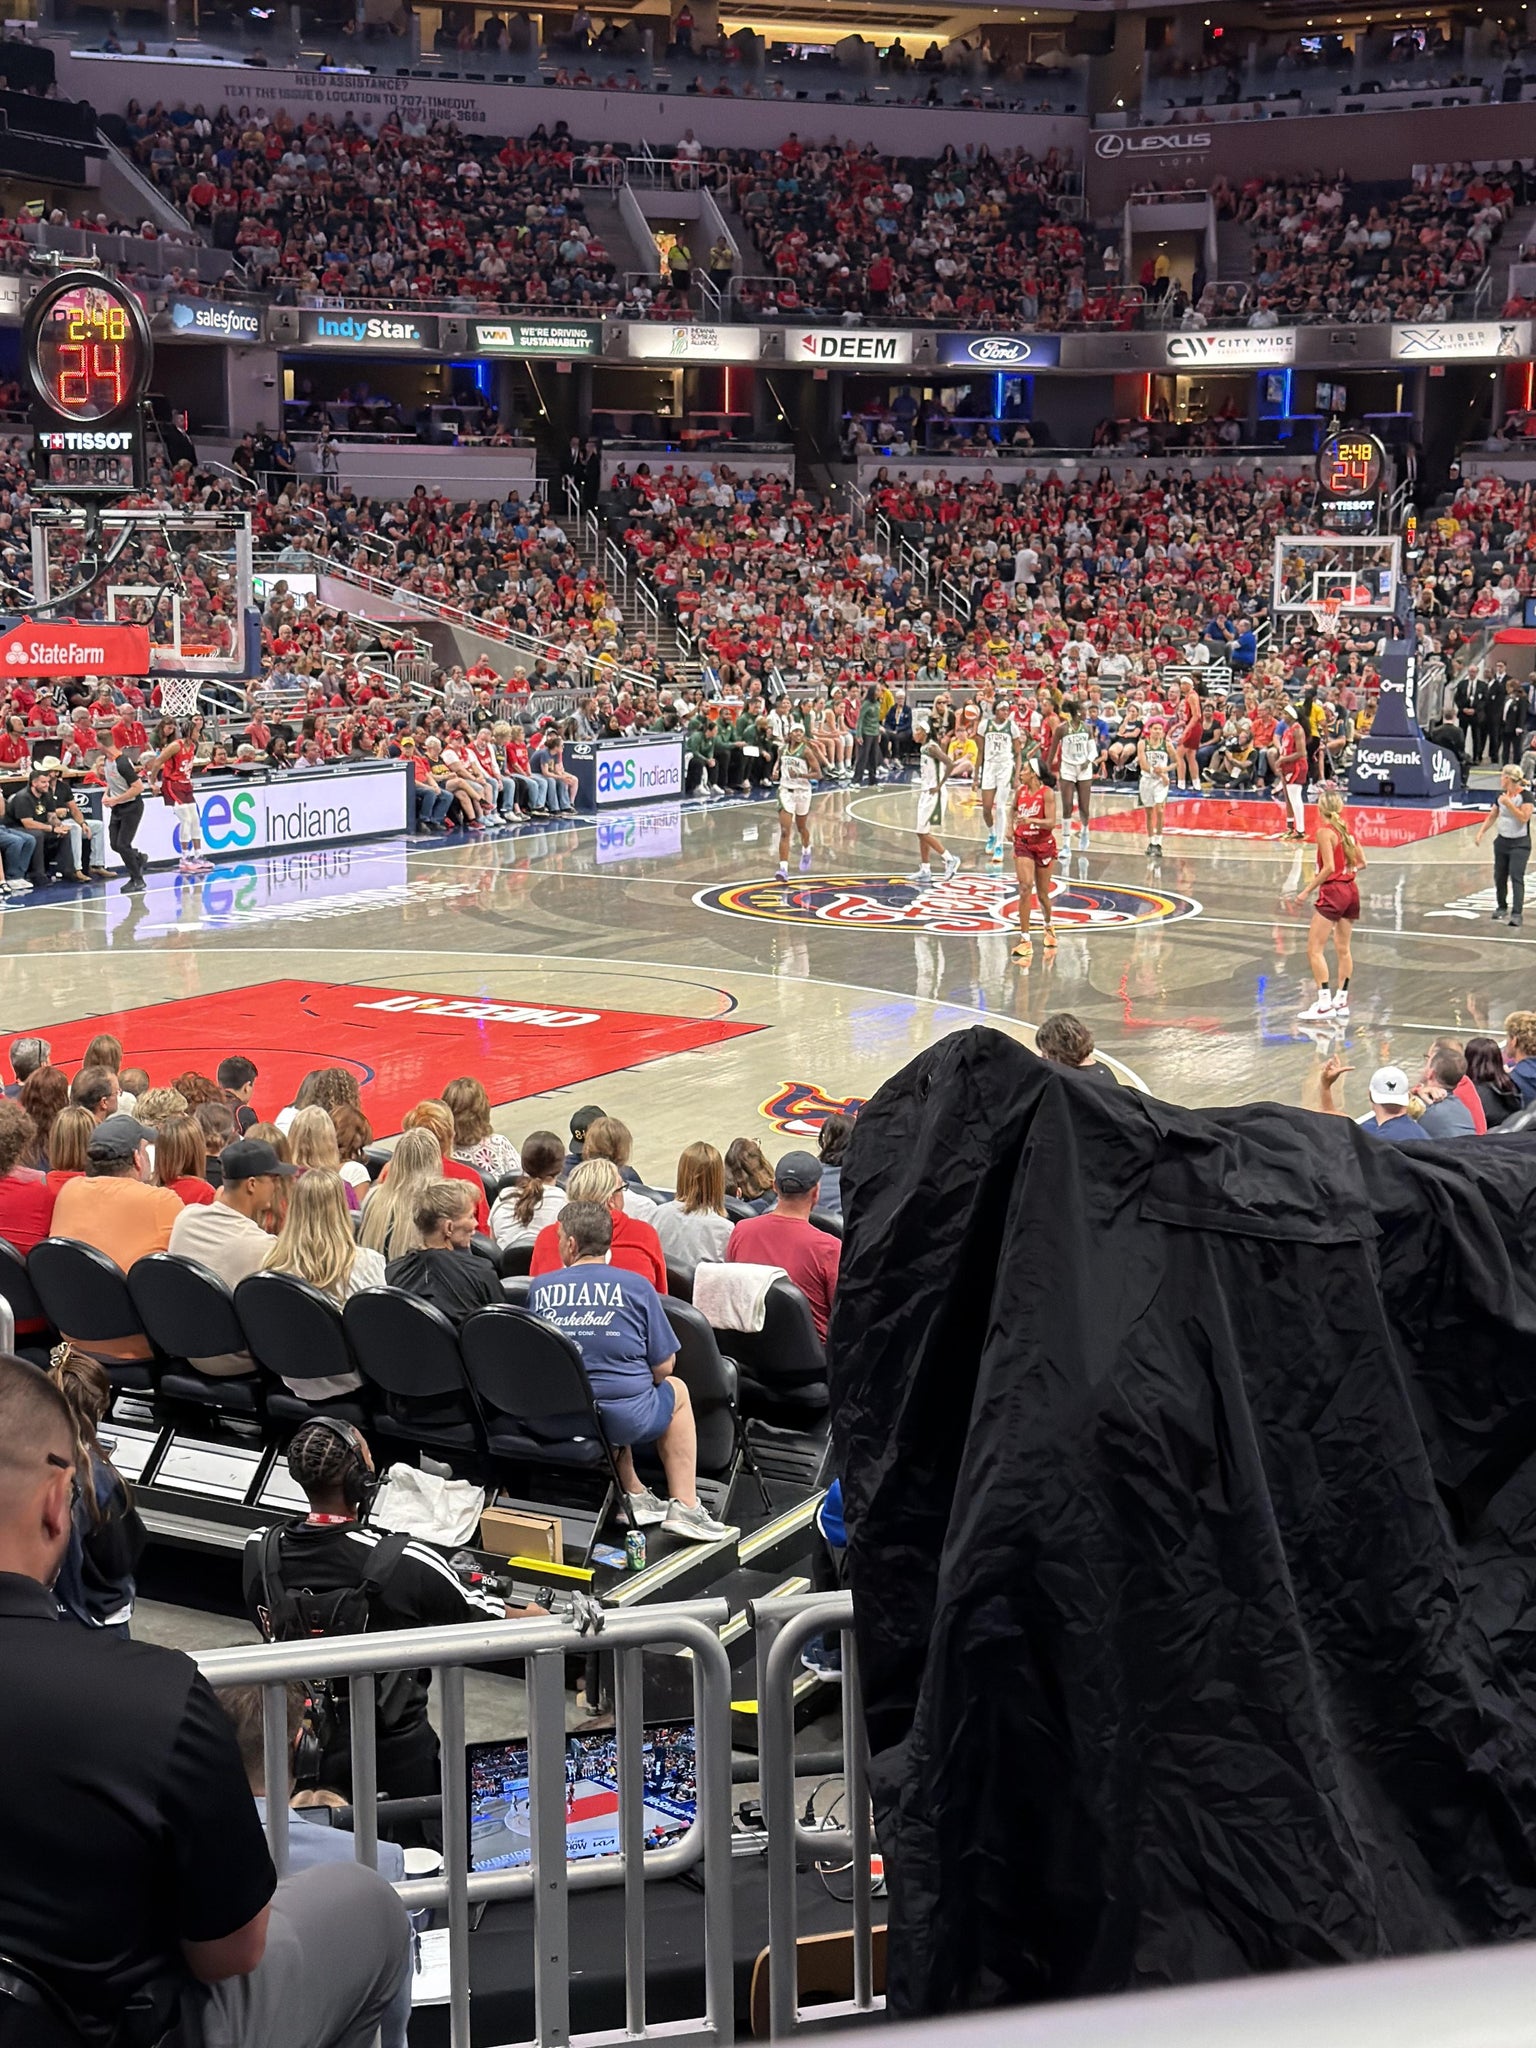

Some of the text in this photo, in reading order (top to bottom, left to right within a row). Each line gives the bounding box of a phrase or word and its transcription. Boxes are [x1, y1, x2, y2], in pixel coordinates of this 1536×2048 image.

[295, 74, 409, 91] NEED ASSISTANCE?
[224, 85, 251, 98] TEXT
[255, 87, 276, 99] THE
[326, 91, 380, 104] LOCATION
[383, 94, 398, 106] TO
[400, 95, 476, 109] 707-TIMEOUT
[1127, 133, 1211, 150] LEXUS
[68, 307, 126, 341] 2:48
[196, 307, 258, 334] salesforce
[520, 327, 588, 338] WE'RE DRIVING
[520, 336, 591, 348] SUSTAINABILITY
[1218, 336, 1293, 347] CITY WIDE
[1438, 331, 1485, 343] XIBER
[821, 337, 897, 359] DEEM
[979, 340, 1018, 359] Ford
[59, 344, 122, 406] 24
[65, 432, 133, 450] TISSOT
[1339, 444, 1372, 461] 2:48
[1331, 461, 1368, 490] 24
[1337, 501, 1375, 510] TISSOT
[1357, 749, 1421, 766] KeyBank
[597, 759, 679, 793] aes Indiana
[1432, 749, 1455, 790] Lilly
[266, 802, 351, 843] Indiana
[535, 1281, 625, 1312] INDIANA
[543, 1307, 616, 1327] Basketball
